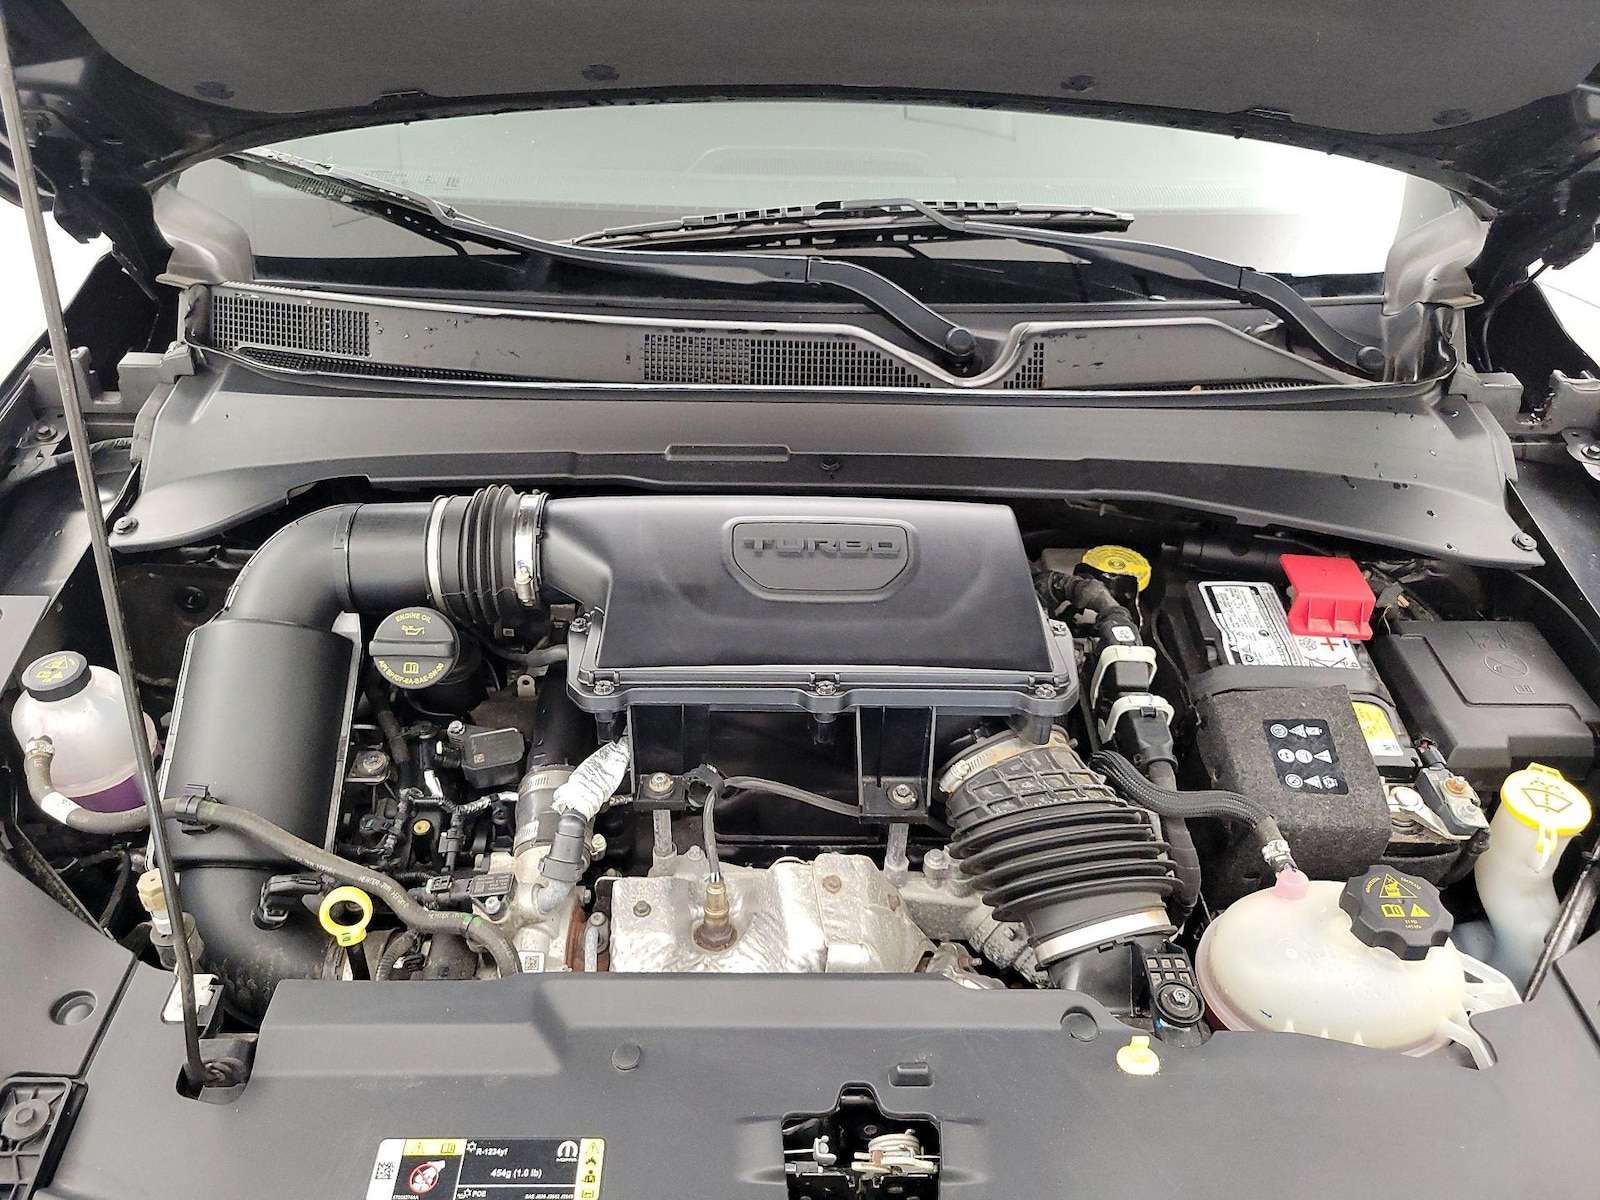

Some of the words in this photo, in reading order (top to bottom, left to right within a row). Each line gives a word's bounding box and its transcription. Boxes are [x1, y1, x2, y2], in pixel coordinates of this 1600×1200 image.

[743, 537, 900, 559] TURBO
[395, 612, 421, 622] ENGINE
[421, 614, 432, 623] OIL
[378, 660, 387, 672] API
[476, 1148, 509, 1157] R-1234yf
[490, 1168, 512, 1179] 454g
[513, 1168, 530, 1179] (1.0
[530, 1168, 543, 1178] lb)
[471, 1190, 487, 1198] POE
